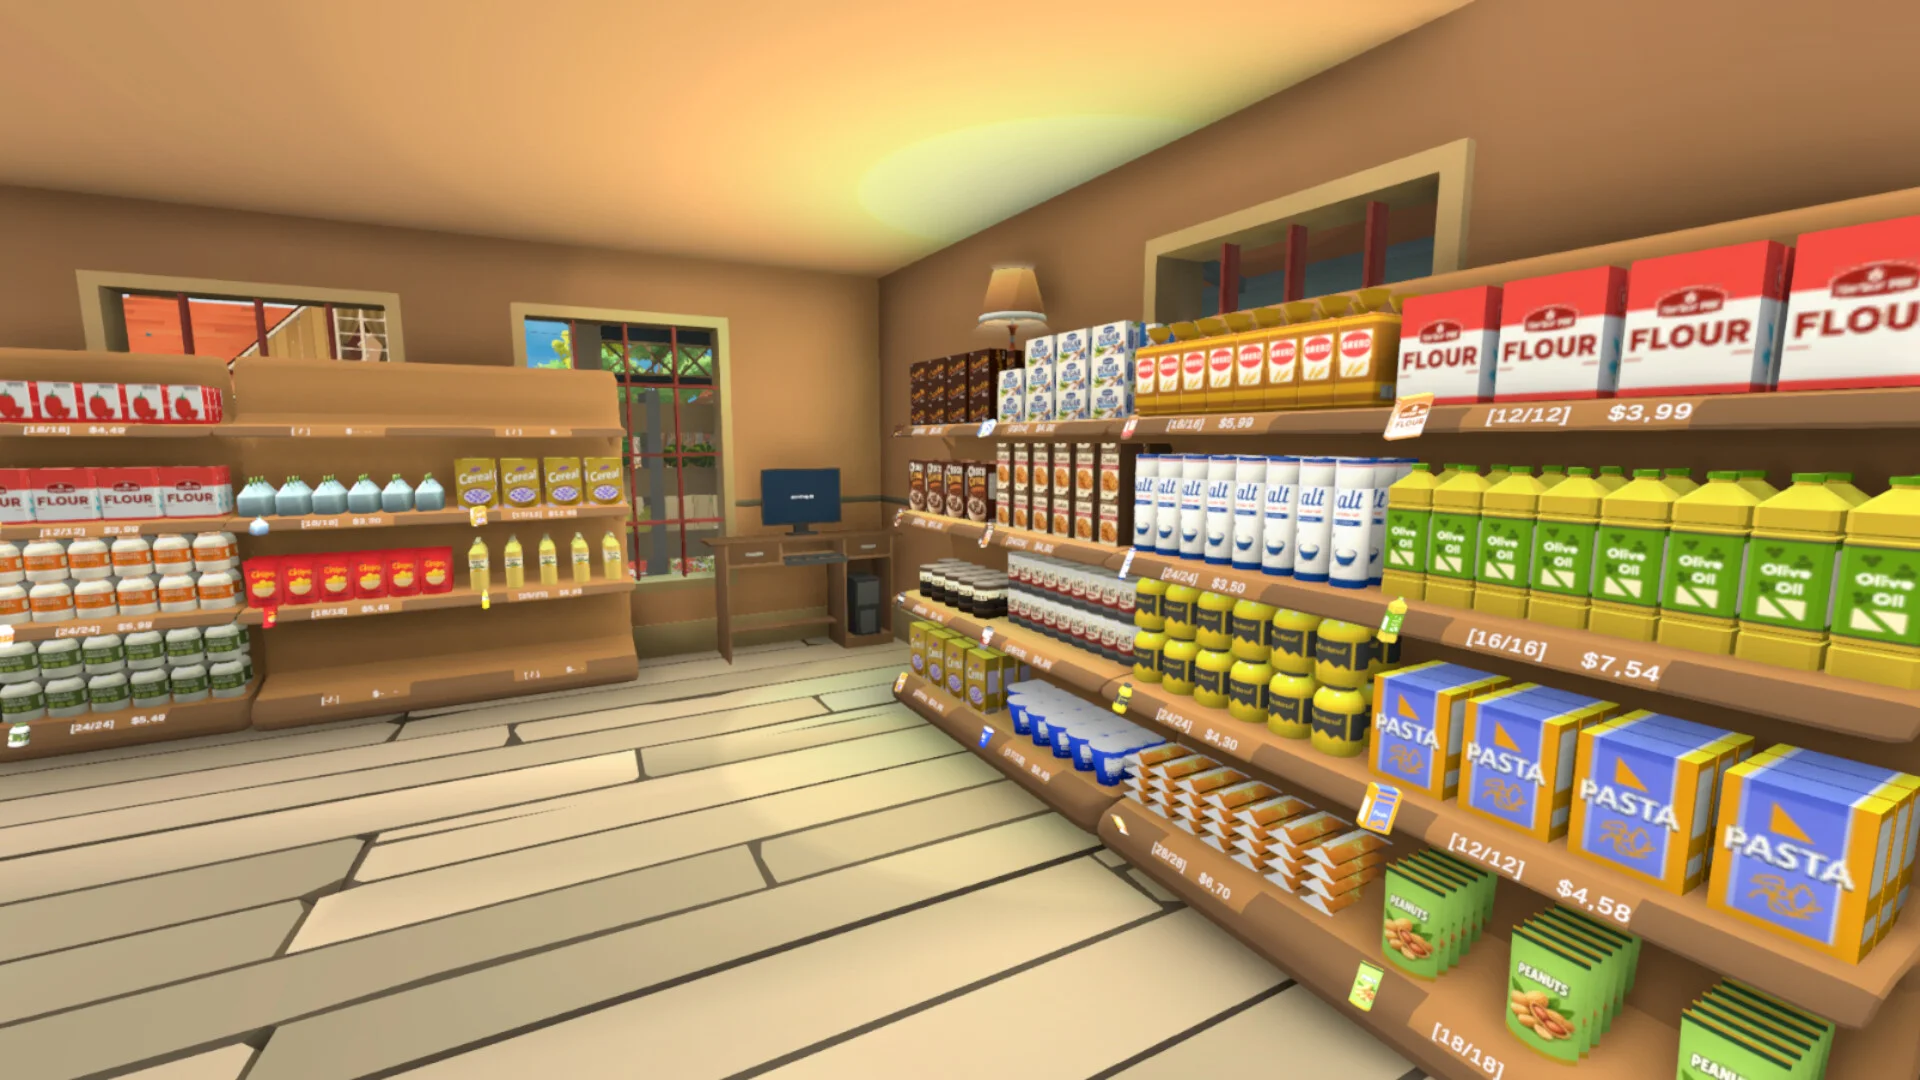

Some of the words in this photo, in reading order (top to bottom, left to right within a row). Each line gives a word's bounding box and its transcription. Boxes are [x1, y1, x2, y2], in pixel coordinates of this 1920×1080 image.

[1794, 300, 1920, 340] FLOU
[1629, 318, 1752, 353] FLOUR
[1503, 333, 1597, 363] FLOUR
[1402, 345, 1477, 371] FLOUR
[1485, 405, 1572, 428] [12/12]
[1607, 402, 1693, 423] $3,99
[459, 471, 493, 485] Cereal
[505, 470, 537, 484] Cereal
[548, 468, 579, 483] Cereal
[590, 467, 619, 482] Cereal
[1157, 479, 1176, 494] alt
[1181, 480, 1201, 496] alt
[1208, 481, 1228, 498] alt
[1236, 482, 1258, 501] alt
[1267, 484, 1290, 504] alt
[37, 495, 89, 507] FLOUR
[103, 493, 153, 505] FLOUR
[167, 491, 214, 503] FLOUR
[1301, 487, 1324, 506] alt
[1337, 490, 1363, 509] alt
[1391, 526, 1417, 538] Olive
[1436, 529, 1465, 543] Olive
[1399, 538, 1414, 549] Oil
[1445, 543, 1461, 555] Oil
[1487, 535, 1518, 549] Olive
[1543, 541, 1578, 555] Olive
[1496, 549, 1514, 561] Oil
[1553, 556, 1573, 568] Oil
[1607, 546, 1647, 562] Olive
[1678, 554, 1724, 571] Olive
[1160, 566, 1199, 587] [24/24]
[1618, 562, 1640, 576] Oil
[1760, 562, 1813, 579] Olive
[1690, 571, 1716, 586] Oil
[1855, 572, 1915, 591] Olive
[1774, 581, 1804, 596] Oil
[1872, 592, 1905, 608] Oil
[1466, 628, 1547, 663] [16/16]
[1580, 651, 1660, 683] $7,54
[70, 720, 115, 735] [24/24]
[1155, 707, 1193, 734] [24/24]
[1375, 712, 1440, 751] PASTA
[1467, 742, 1546, 787] PASTA
[1580, 778, 1680, 833] PASTA
[1151, 840, 1188, 875] [28/28]
[1724, 825, 1855, 892] PASTA
[1448, 832, 1526, 881] [12/12]
[1556, 879, 1632, 923] $4,58
[1389, 894, 1429, 923] PEANUTS
[1517, 961, 1569, 997] PEANUTS
[1431, 1021, 1505, 1080] [18/18]
[1691, 1053, 1745, 1080] PEANU
